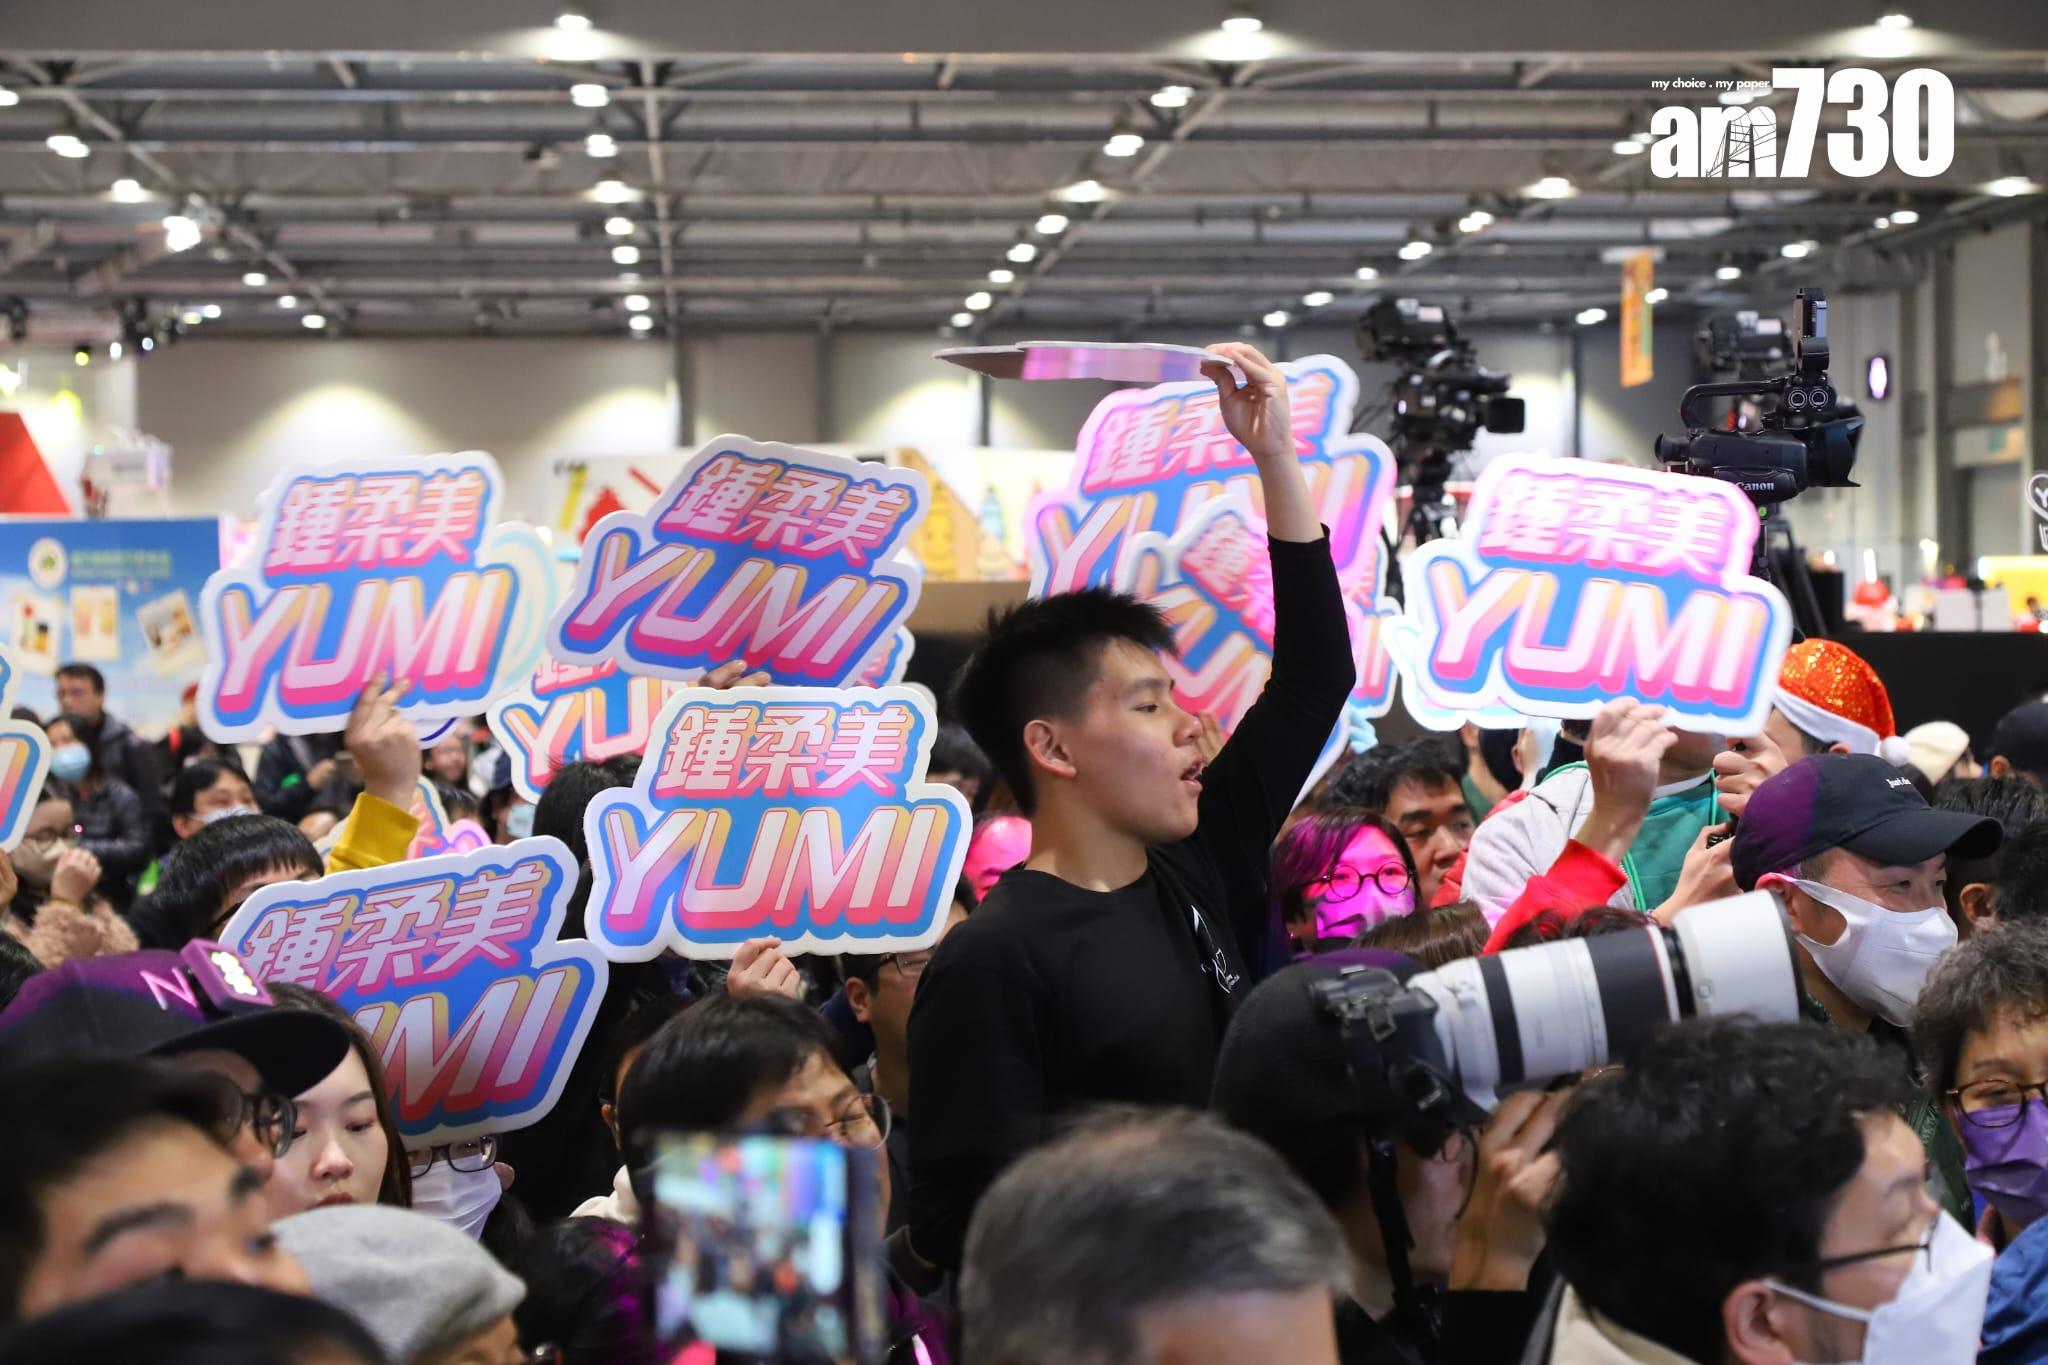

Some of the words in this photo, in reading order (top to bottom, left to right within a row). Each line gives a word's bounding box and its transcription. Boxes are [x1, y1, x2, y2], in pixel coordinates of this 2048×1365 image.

[265, 469, 487, 576] 鍾柔美
[657, 452, 910, 566] 鍾柔美
[1478, 469, 1738, 583] 鍾柔美
[215, 568, 518, 713] YUMI
[561, 533, 899, 679] YUMI
[1429, 559, 1766, 708] YUMI
[501, 676, 697, 787] YU
[654, 706, 914, 797] 鍾柔美
[246, 861, 549, 993] 鍾柔美
[605, 808, 946, 930] YUMI
[351, 965, 581, 1121] MI
